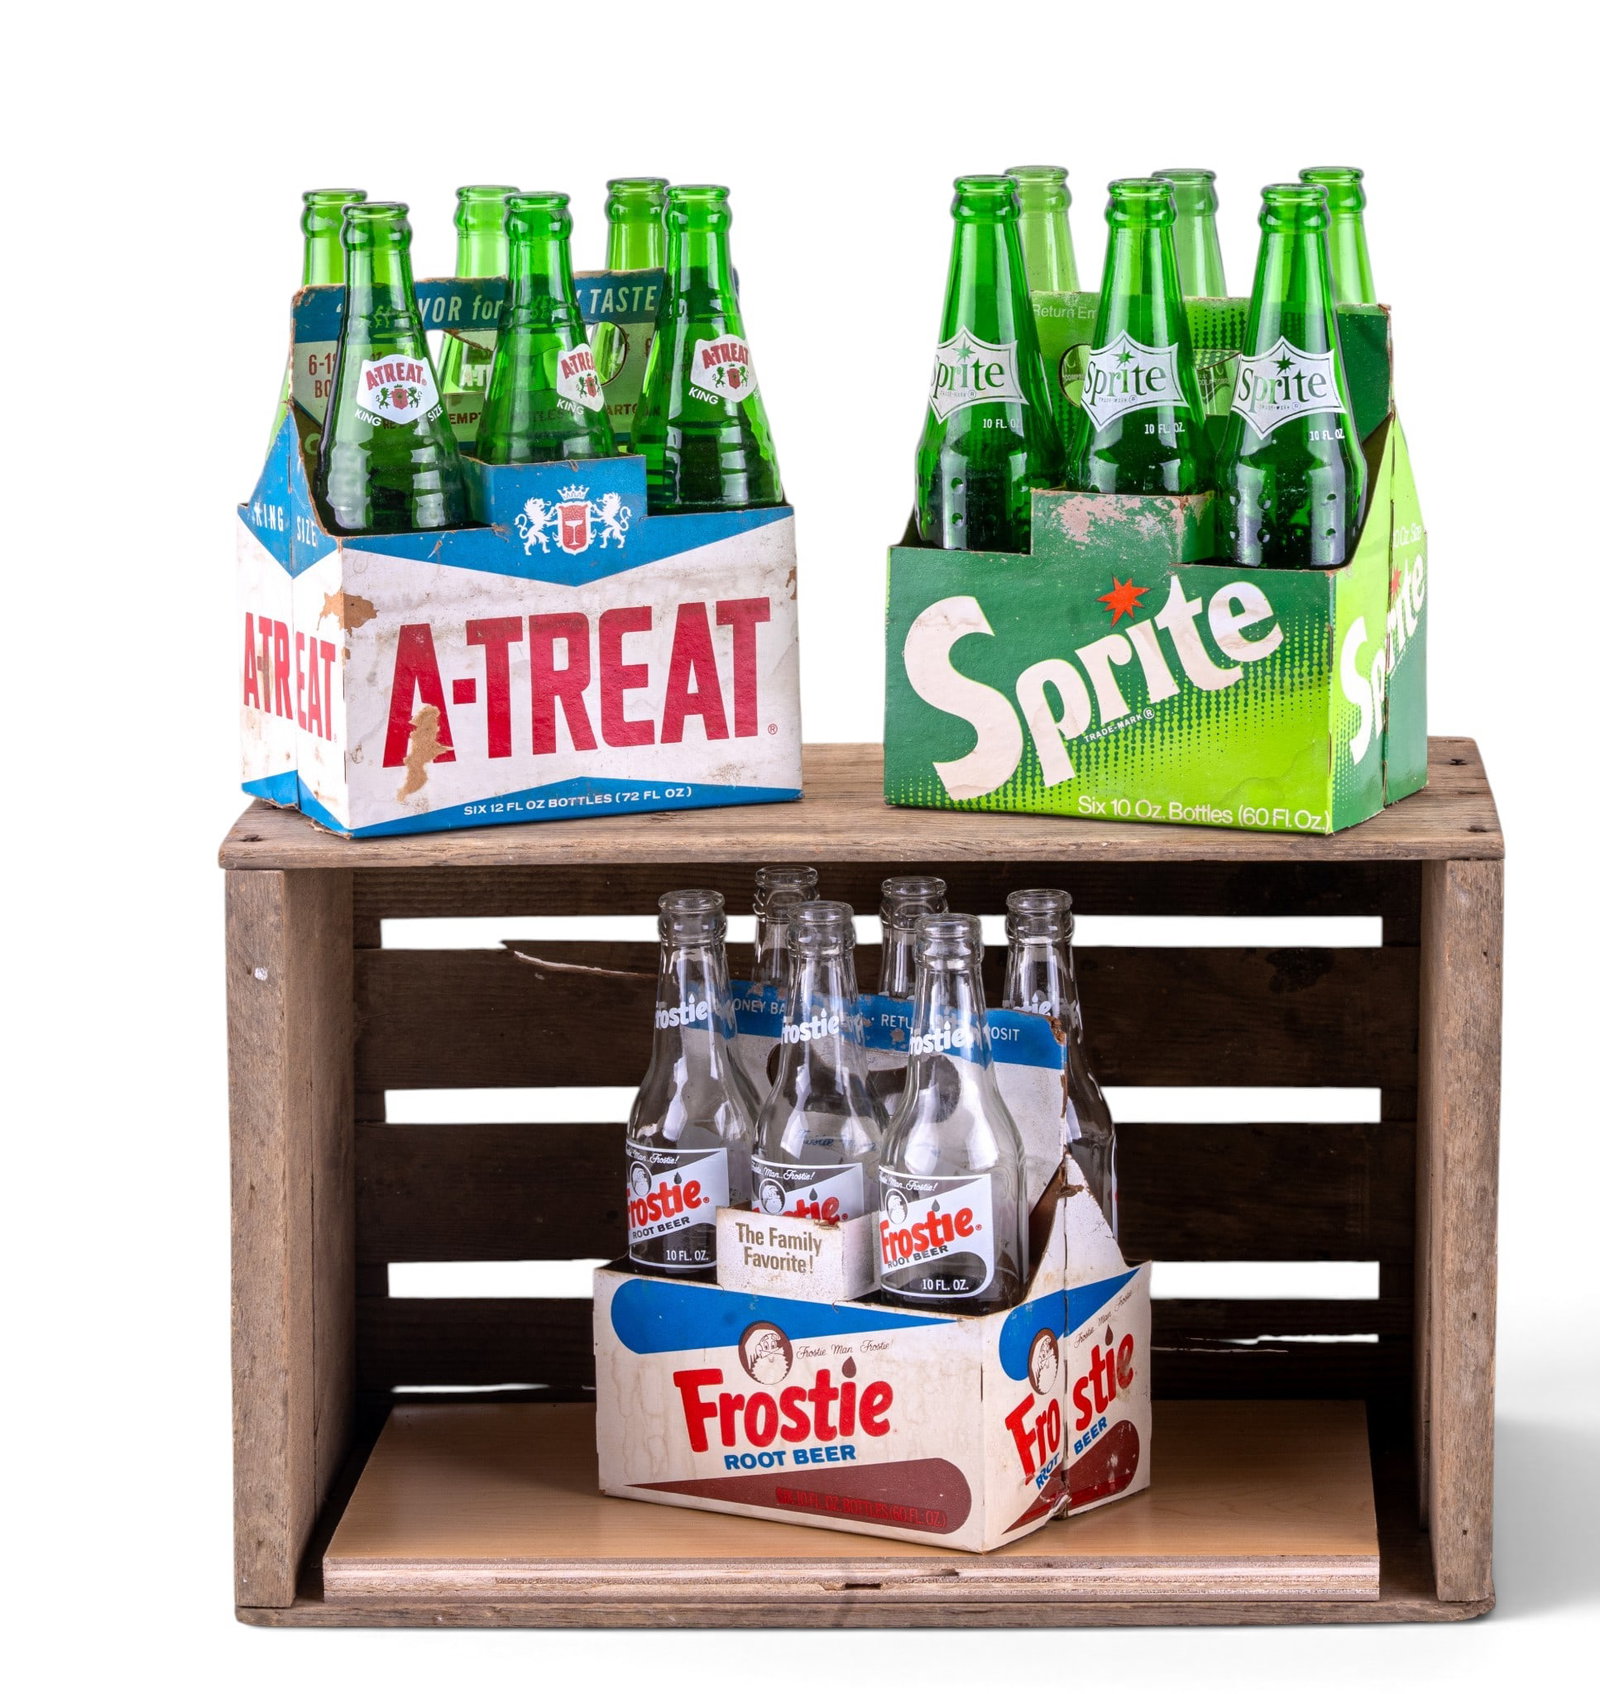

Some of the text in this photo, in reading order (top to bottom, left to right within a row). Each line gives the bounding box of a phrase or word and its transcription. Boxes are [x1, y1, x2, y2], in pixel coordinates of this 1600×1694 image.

[418, 296, 462, 323] VOR
[472, 294, 503, 321] for
[590, 285, 658, 315] TASTE
[1084, 346, 1167, 407] Sprite
[1238, 353, 1328, 414] Sprite
[556, 398, 584, 416] KING
[688, 386, 719, 405] KING
[355, 408, 382, 427] KING
[427, 404, 444, 422] SIZE
[450, 411, 481, 425] EMP
[982, 418, 993, 429] 10
[1144, 423, 1155, 435] 10
[1309, 430, 1320, 441] 10
[253, 501, 317, 548] KING SIZE
[1340, 553, 1426, 765] Sprite
[382, 596, 772, 768] A-TREAT
[903, 574, 1284, 800] Sprite
[1083, 714, 1143, 743] TRADE-MARK
[463, 786, 692, 816] SIX 12 FL OZ BOTTLES (72 FL OZ)
[1078, 795, 1107, 816] Six
[1110, 798, 1132, 817] 10
[1135, 799, 1166, 820] Oz.
[1168, 801, 1233, 824] Bottles
[1238, 804, 1269, 827] (60
[1272, 808, 1292, 828] Fl.
[655, 993, 708, 1029] rostie
[734, 998, 1020, 1041] ONEY BA RETU OSIT
[782, 1008, 840, 1044] rostie
[910, 1020, 967, 1056] rostie
[632, 1216, 691, 1240] ROOT BEER
[735, 1221, 822, 1257] The Family
[880, 1199, 975, 1265] Frostie
[666, 1249, 677, 1261] 10
[887, 1244, 949, 1269] ROOT BEER
[922, 1279, 933, 1290] 10
[796, 1338, 894, 1360] Frostie Man Frostie!
[673, 1355, 894, 1453] Frostie
[1073, 1415, 1108, 1456] BEER
[724, 1444, 857, 1471] ROOT BEER
